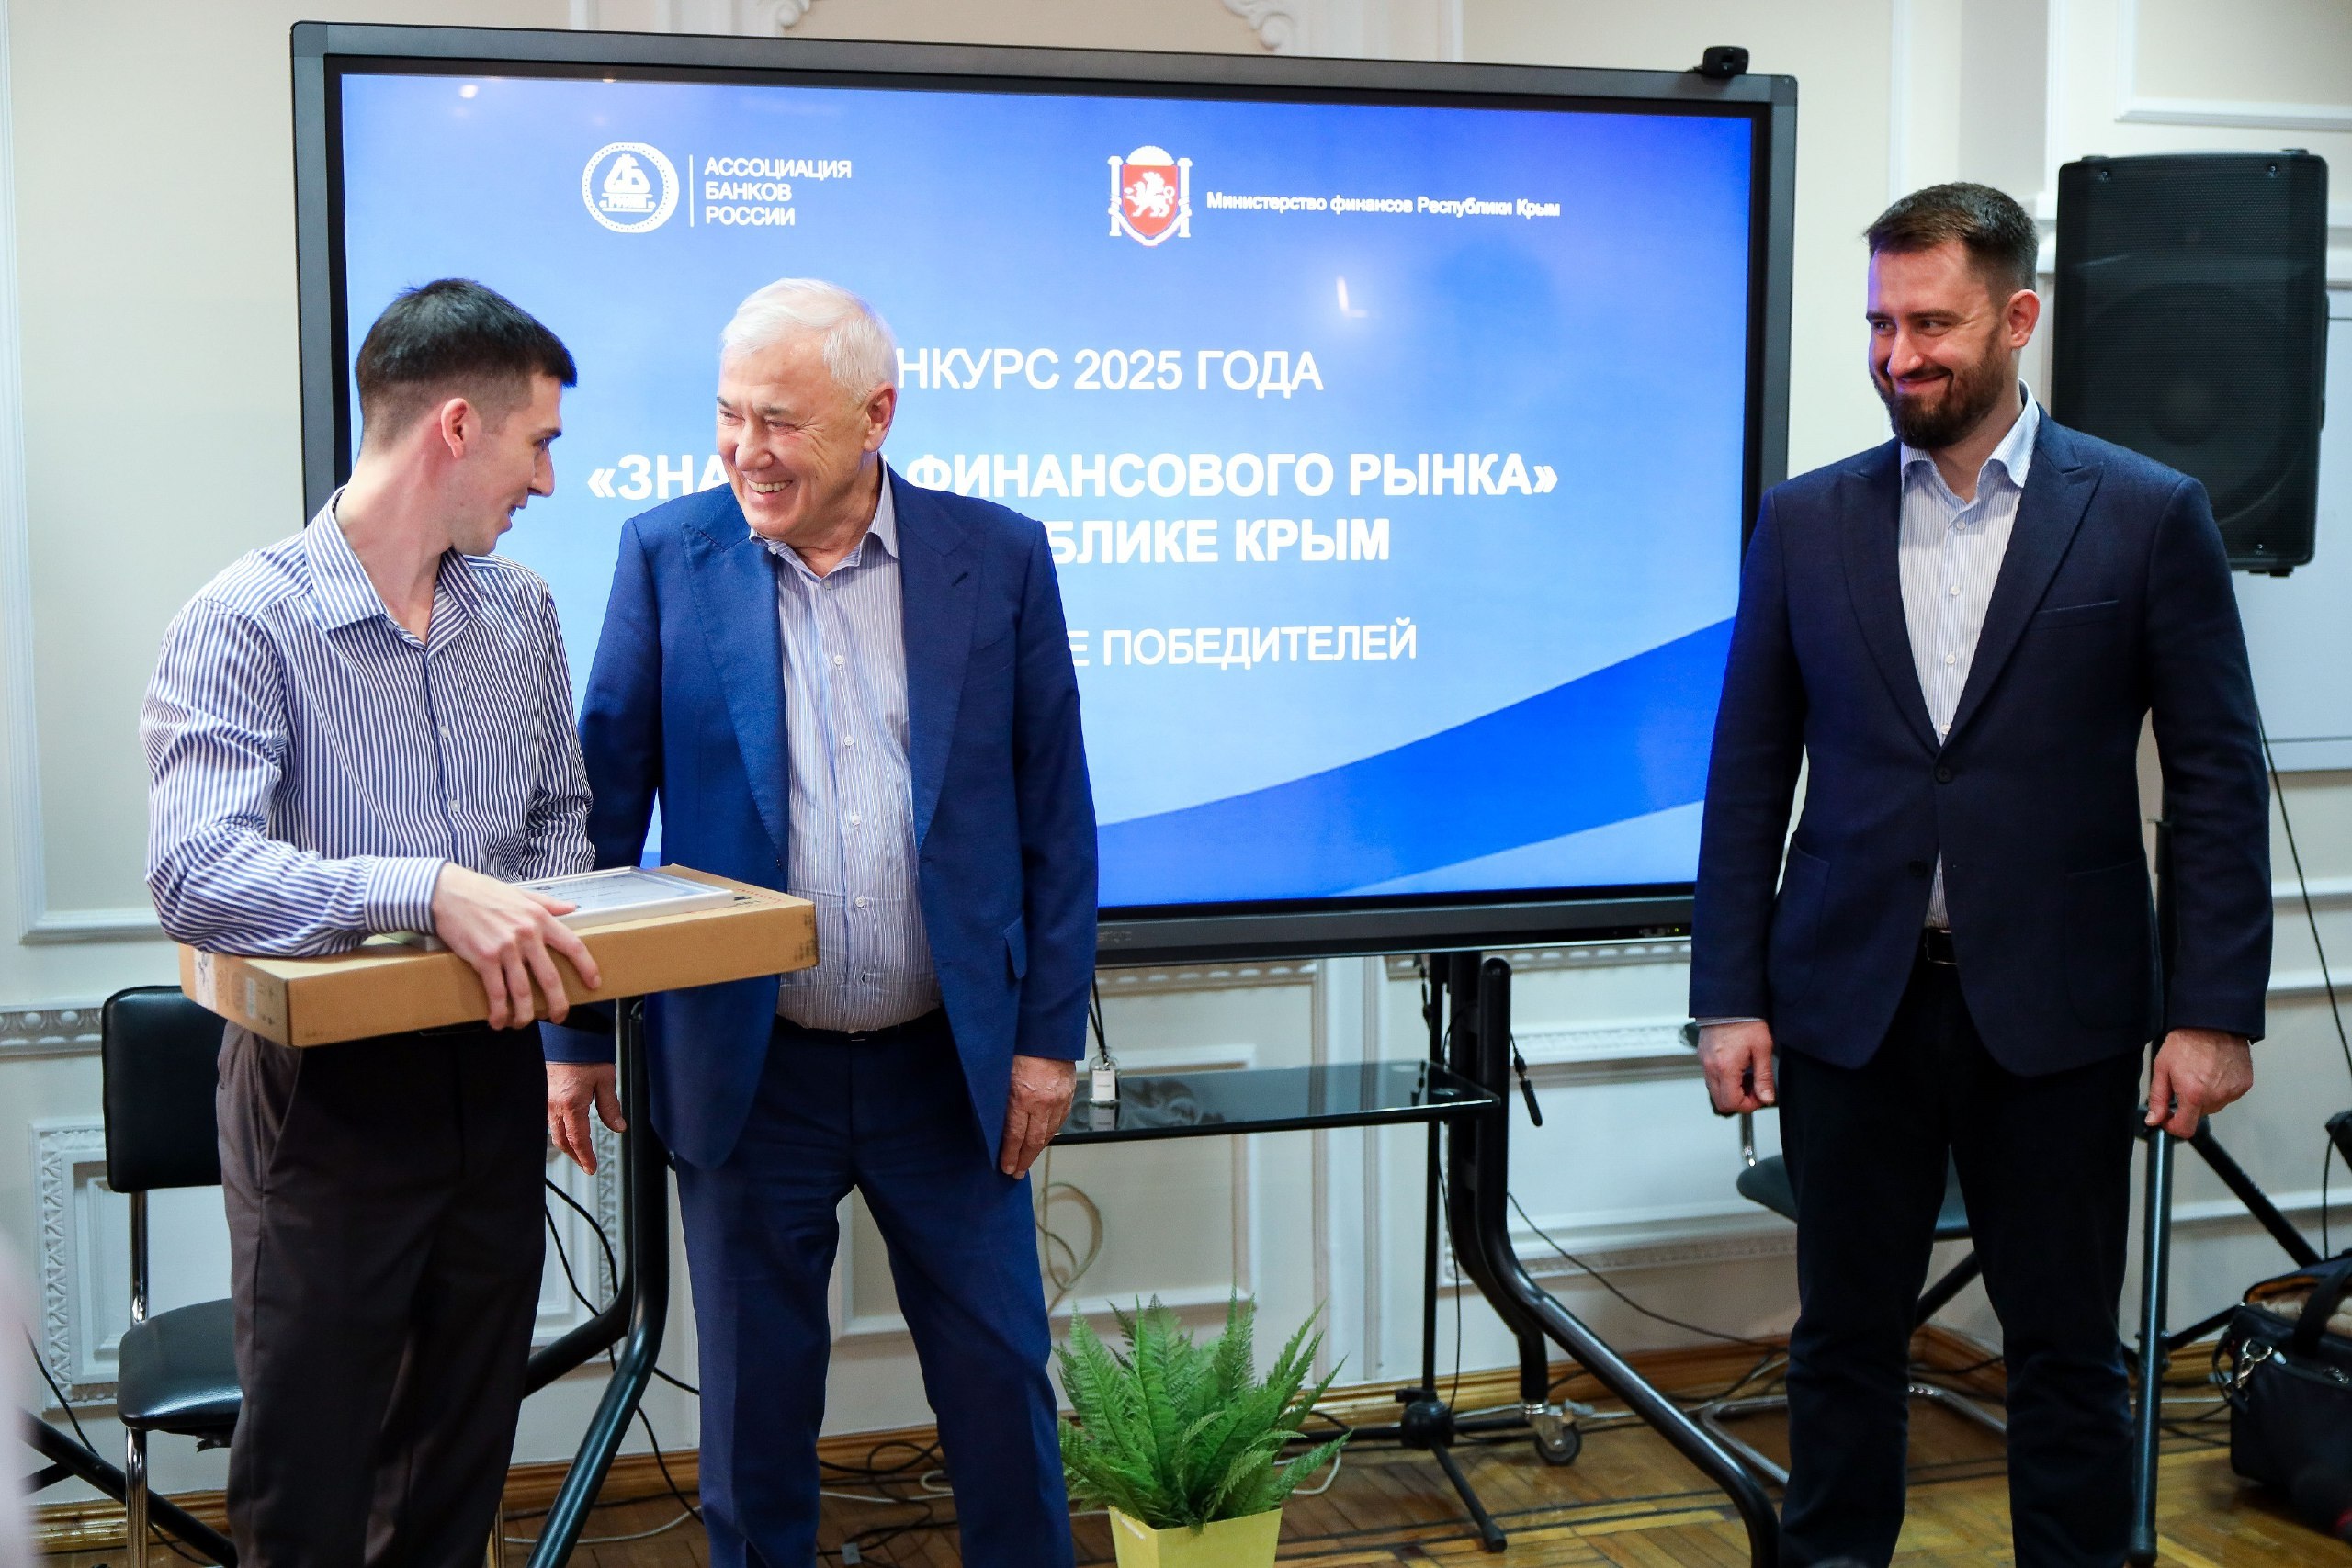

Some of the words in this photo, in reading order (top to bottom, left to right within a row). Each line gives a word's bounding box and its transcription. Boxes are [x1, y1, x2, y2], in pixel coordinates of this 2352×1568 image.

[704, 156, 853, 180] АССОЦИАЦИЯ
[705, 180, 793, 202] БАНКОВ
[1205, 190, 1328, 214] Министерство
[1329, 194, 1414, 215] финансов
[1417, 196, 1513, 218] Республики
[1516, 198, 1561, 220] Крым
[705, 205, 796, 227] РОССИИ
[896, 347, 1060, 390] НКУРС
[1073, 348, 1182, 390] 2025
[1197, 349, 1324, 399] ГОДА
[587, 454, 729, 501] «ЗНА
[906, 452, 1334, 498] ФИНАНСОВОГО
[1349, 453, 1559, 496] РЫНКА»
[1044, 519, 1218, 564] БЛИКЕ
[1235, 518, 1390, 562] КРЫМ
[1103, 616, 1417, 671] ПОБЕДИТЕЛЕЙ
